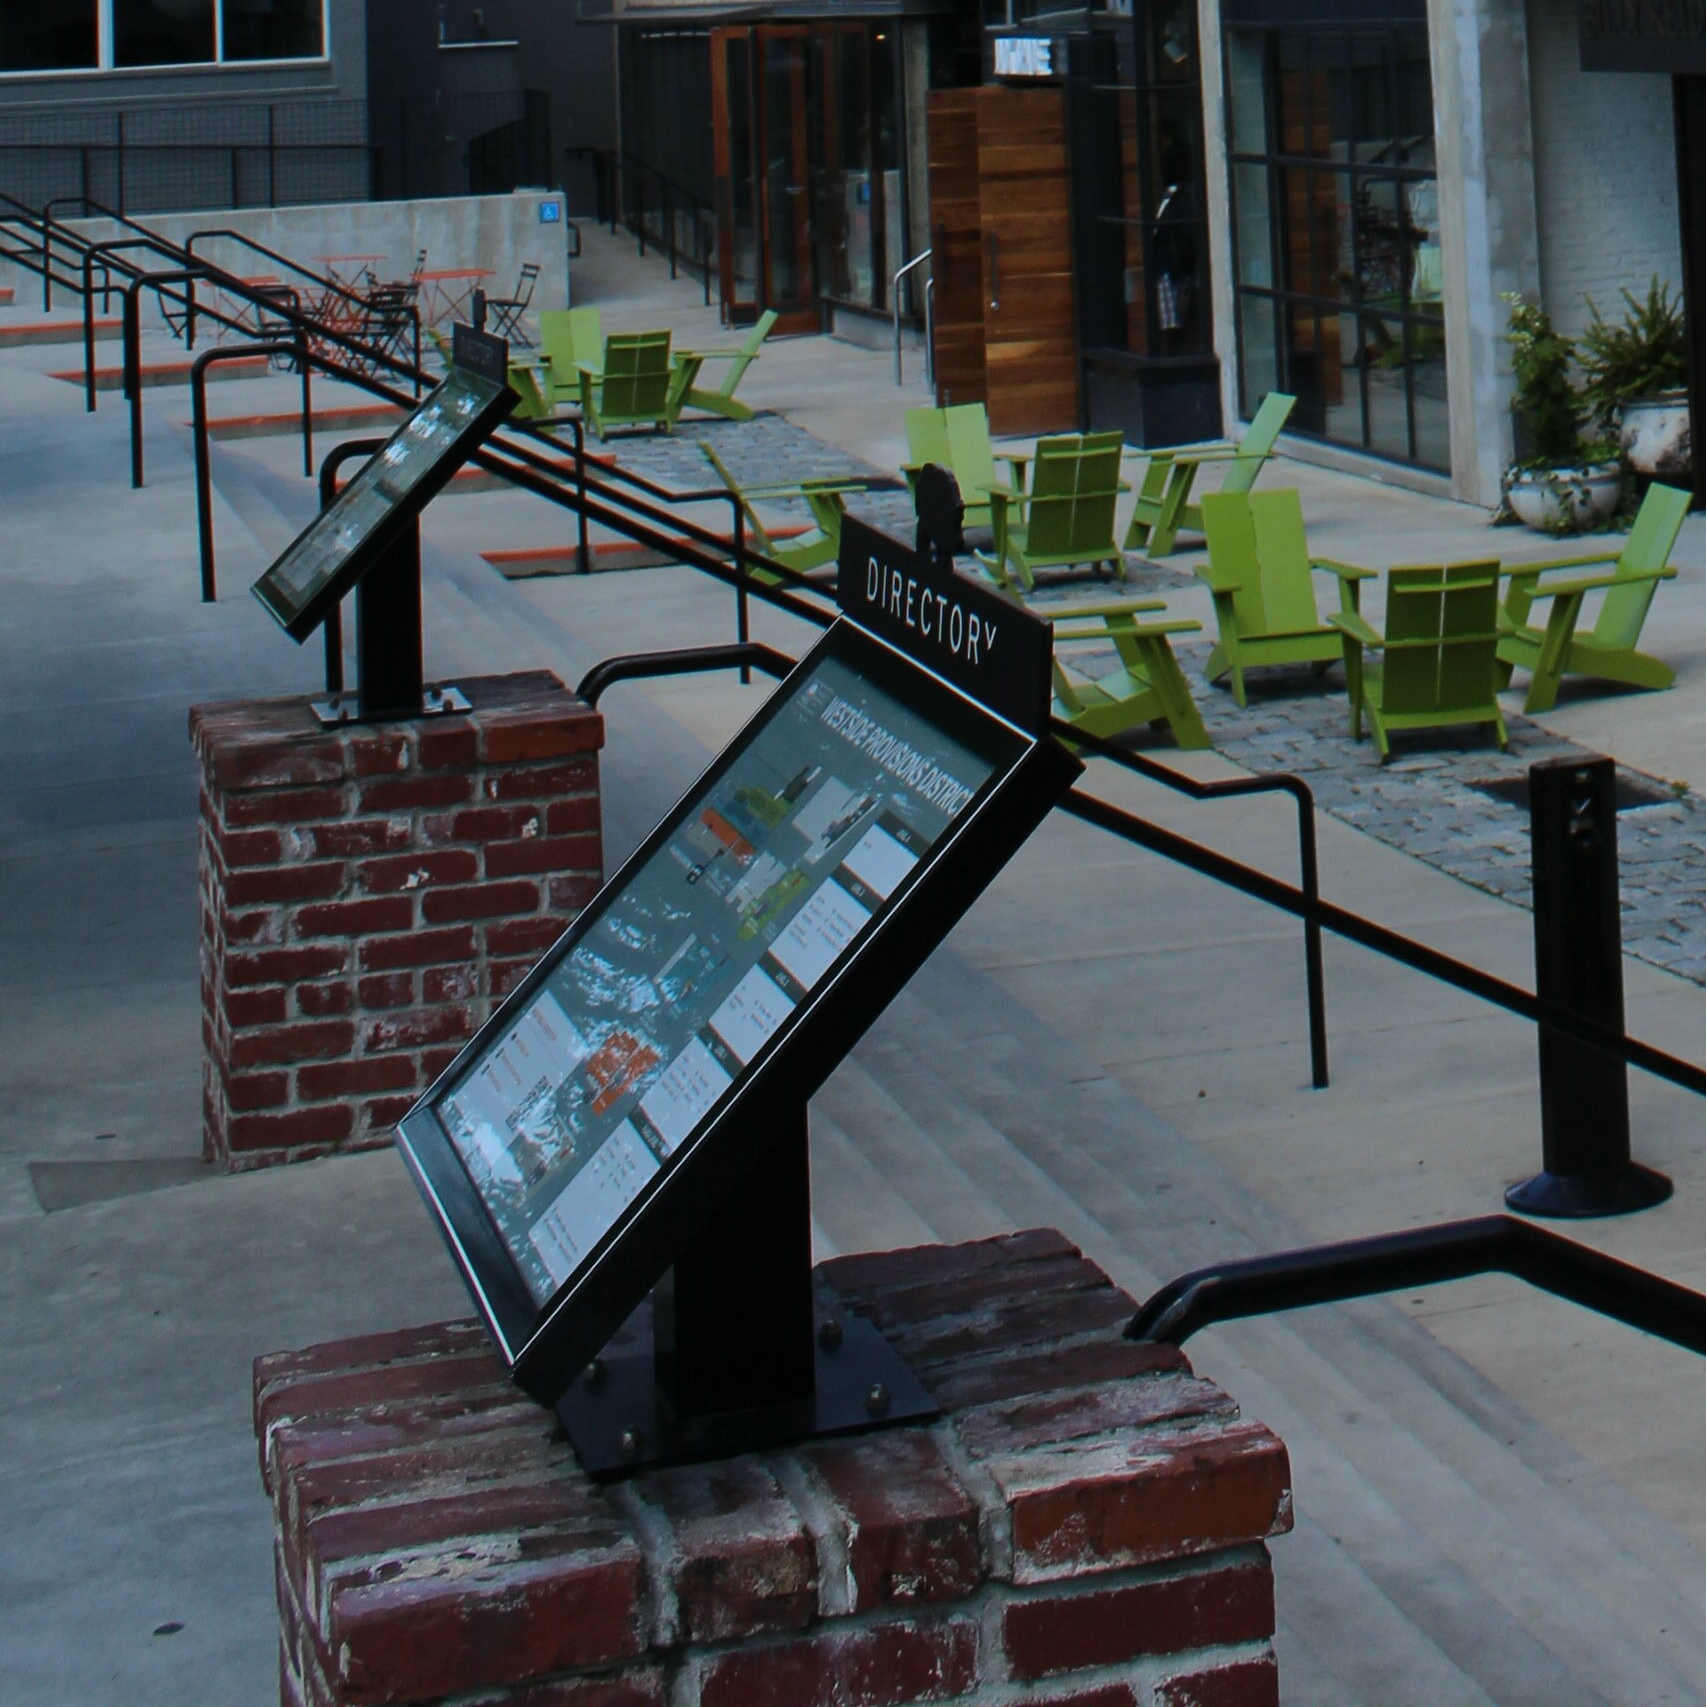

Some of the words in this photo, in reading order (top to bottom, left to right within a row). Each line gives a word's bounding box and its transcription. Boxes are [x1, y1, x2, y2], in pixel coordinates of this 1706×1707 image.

[866, 556, 998, 666] DIRECTORY
[821, 695, 875, 746] WESTSIDE
[859, 725, 931, 787] PROVISIONS
